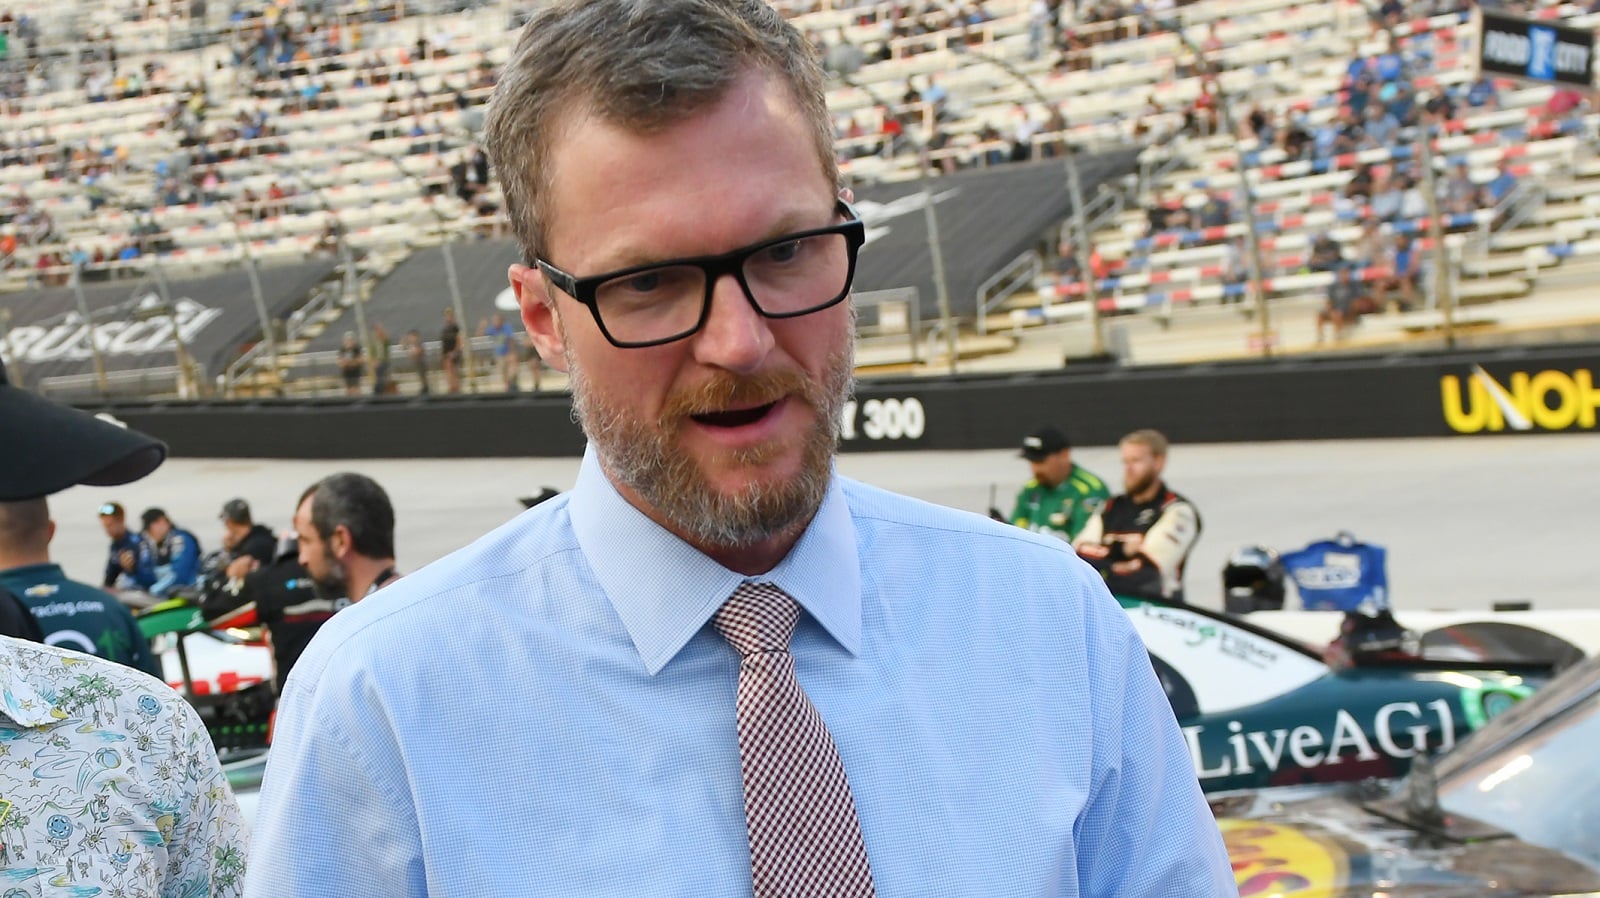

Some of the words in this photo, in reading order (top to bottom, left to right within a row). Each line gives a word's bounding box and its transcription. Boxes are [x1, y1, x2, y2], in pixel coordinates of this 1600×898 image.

[1484, 29, 1530, 66] FOOD
[1555, 40, 1590, 75] CITY
[863, 397, 925, 440] 300
